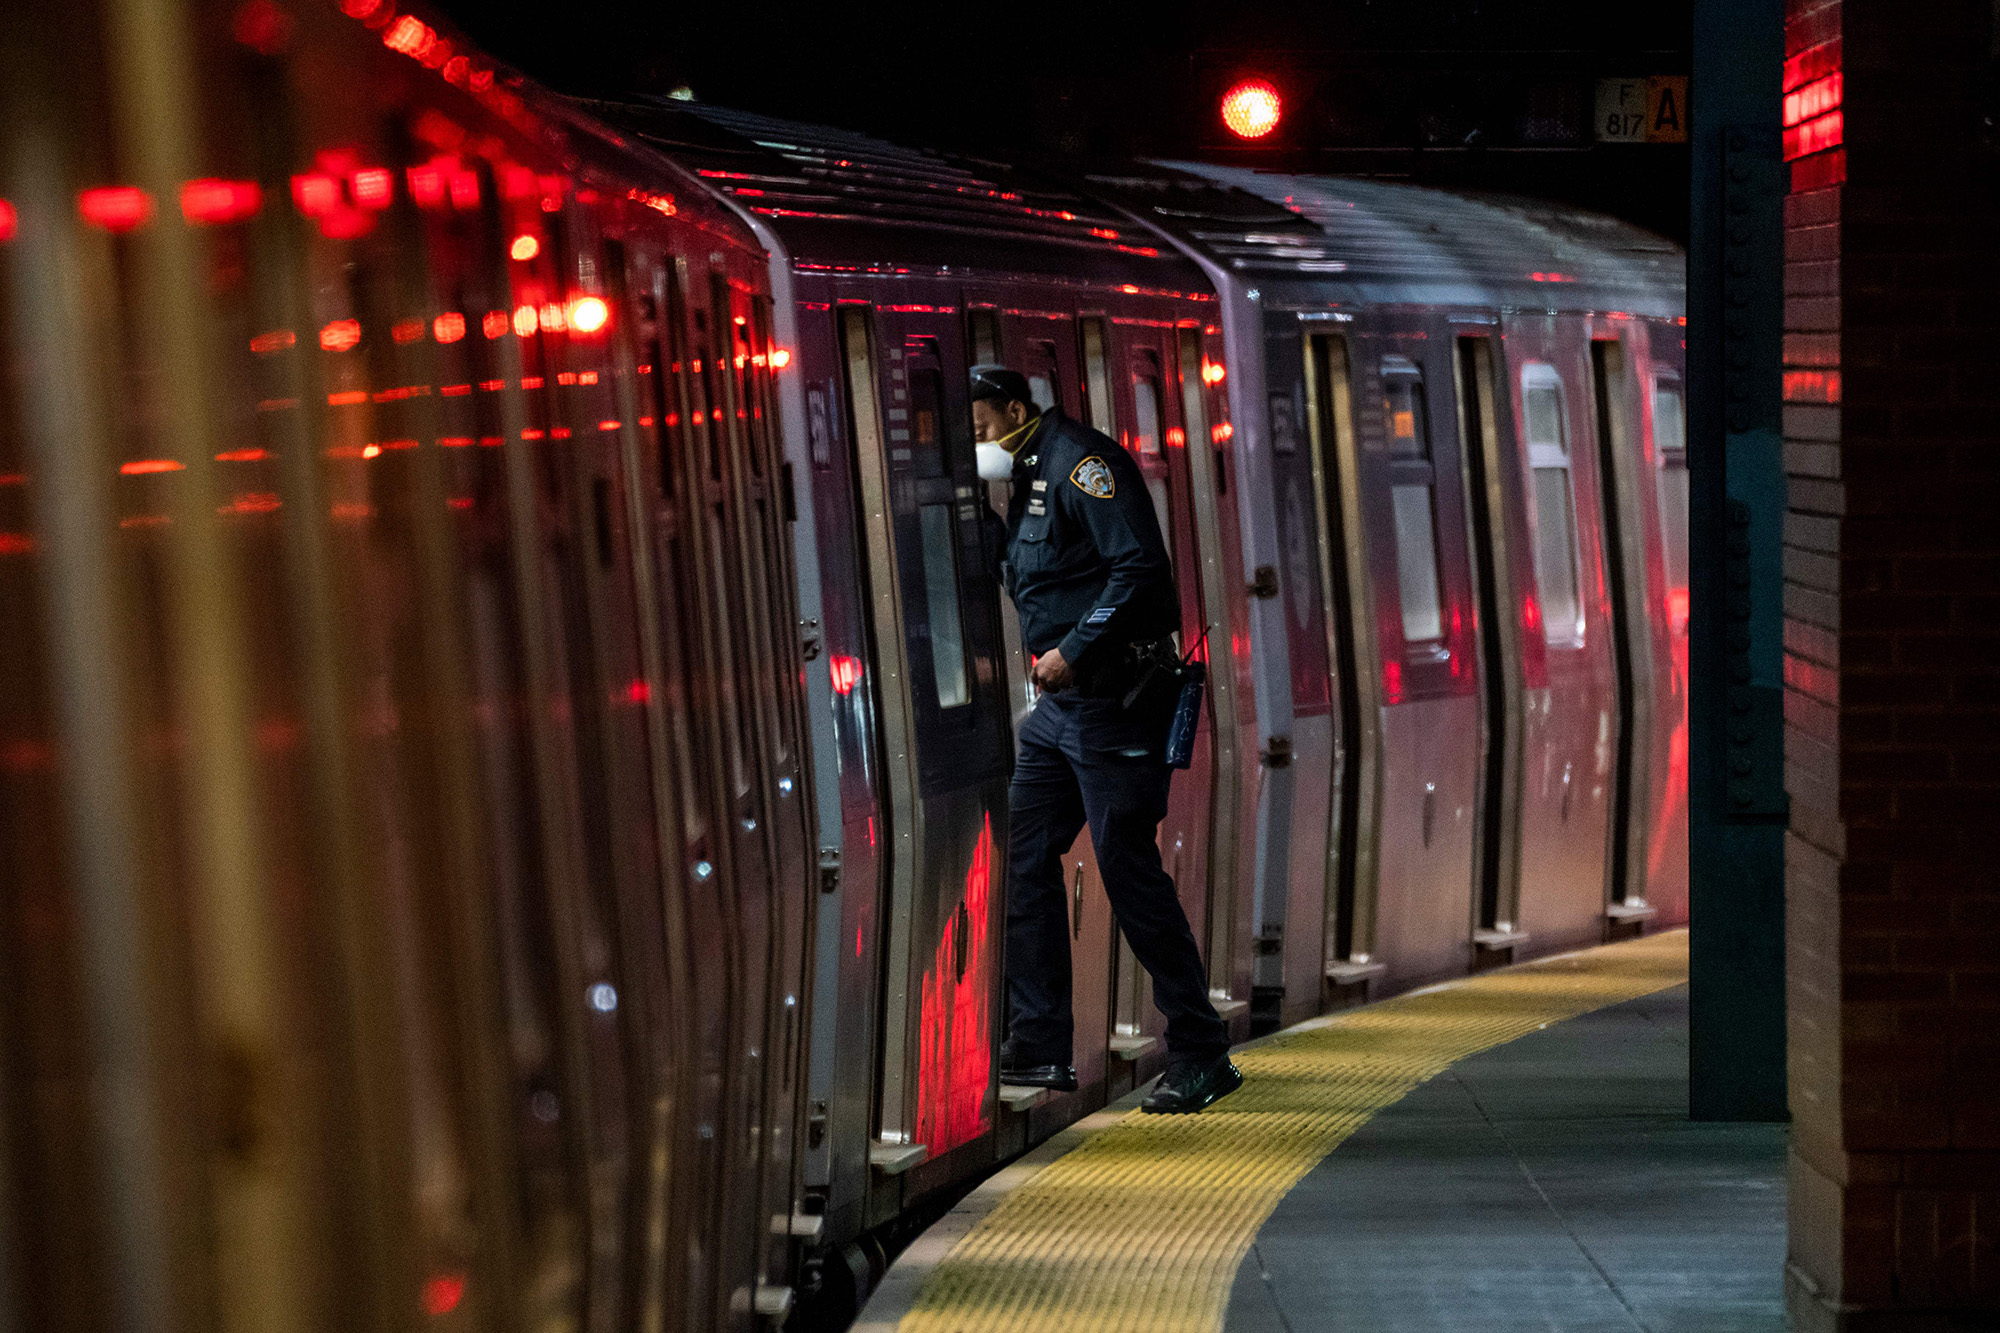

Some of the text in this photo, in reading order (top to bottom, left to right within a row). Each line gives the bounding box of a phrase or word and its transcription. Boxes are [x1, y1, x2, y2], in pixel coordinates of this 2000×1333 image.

[1620, 84, 1634, 106] F
[1655, 88, 1678, 130] A
[1607, 113, 1644, 135] 817
